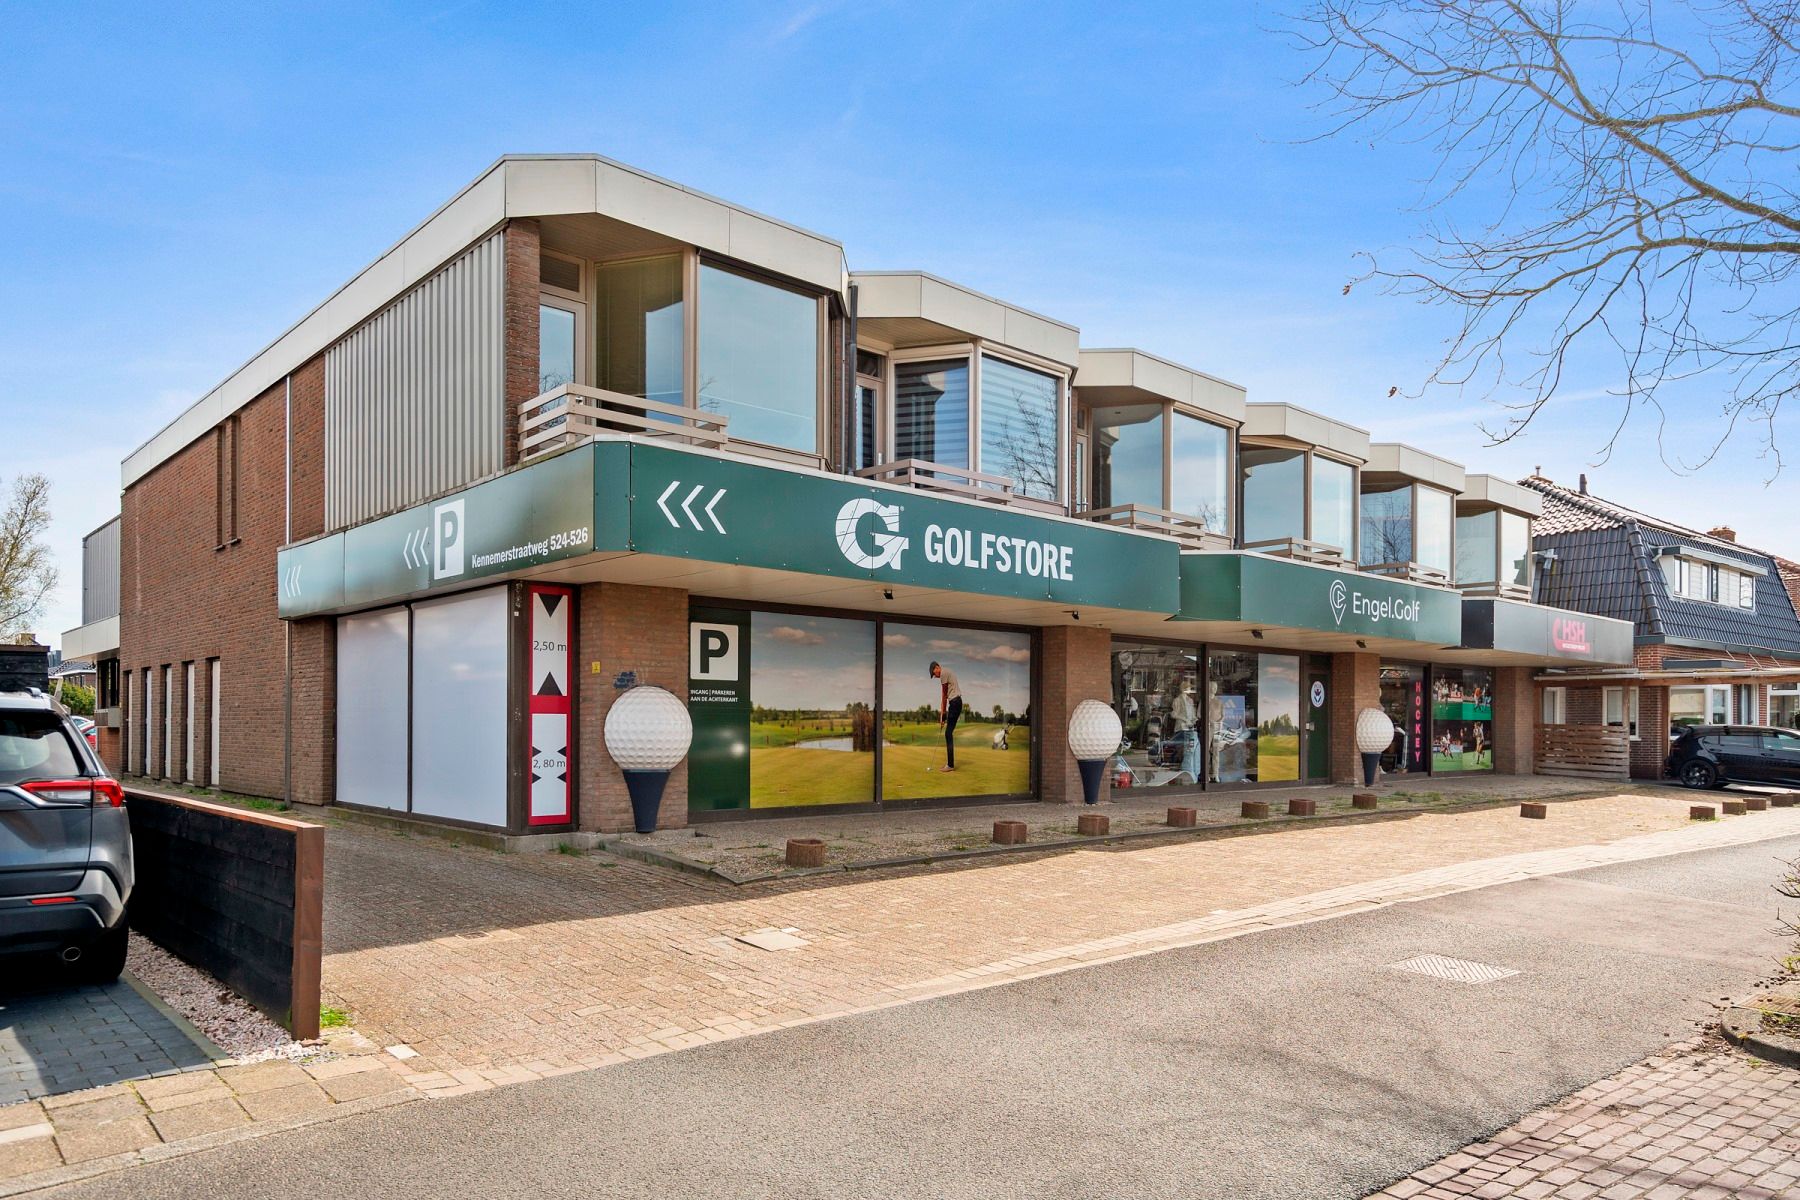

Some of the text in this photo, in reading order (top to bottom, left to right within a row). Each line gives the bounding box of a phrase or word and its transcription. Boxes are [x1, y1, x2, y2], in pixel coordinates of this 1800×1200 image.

[440, 510, 459, 571] P
[471, 527, 588, 569] Kennemerstraatweg 524-526
[924, 524, 1073, 581] GOLFSTORE
[1353, 592, 1420, 622] Engel.Golf
[533, 640, 555, 651] 2,50
[1562, 619, 1585, 643] HSH
[700, 629, 729, 673] P
[556, 760, 566, 768] m
